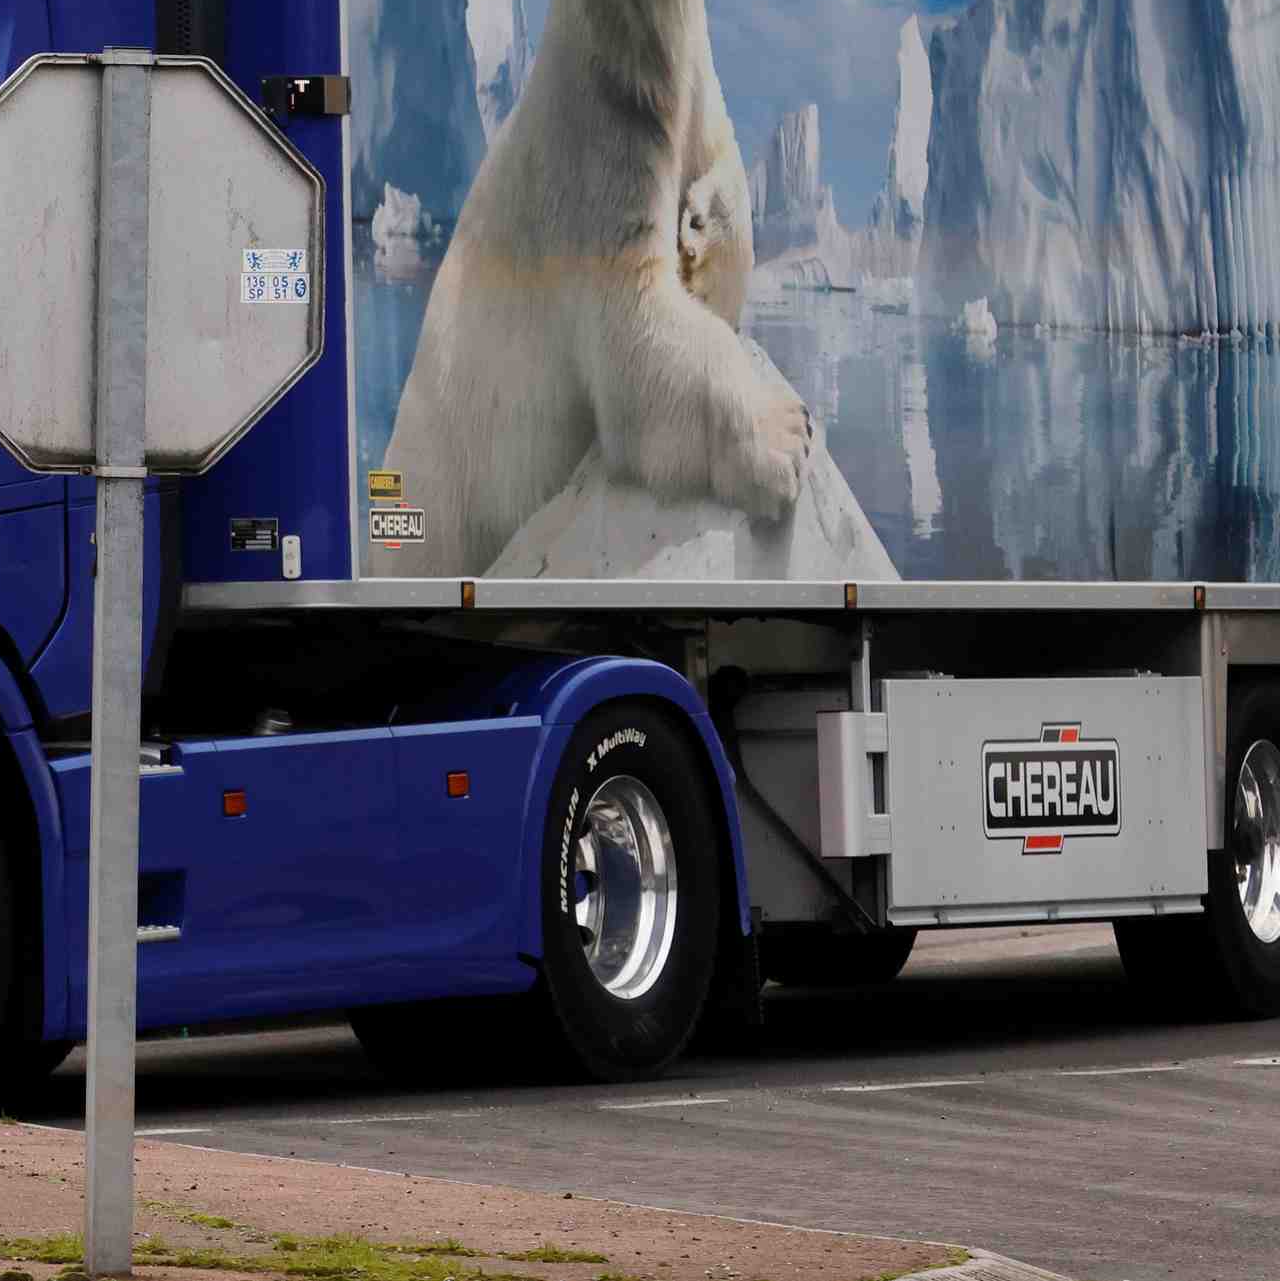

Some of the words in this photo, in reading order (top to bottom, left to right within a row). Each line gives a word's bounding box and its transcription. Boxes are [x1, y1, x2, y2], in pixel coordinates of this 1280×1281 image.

[247, 275, 265, 288] 136
[248, 288, 264, 299] SP
[372, 515, 423, 537] CHEREAU
[597, 727, 647, 760] MultiWay
[988, 760, 1115, 818] CHEREAU
[560, 786, 580, 913] MICHELIN
